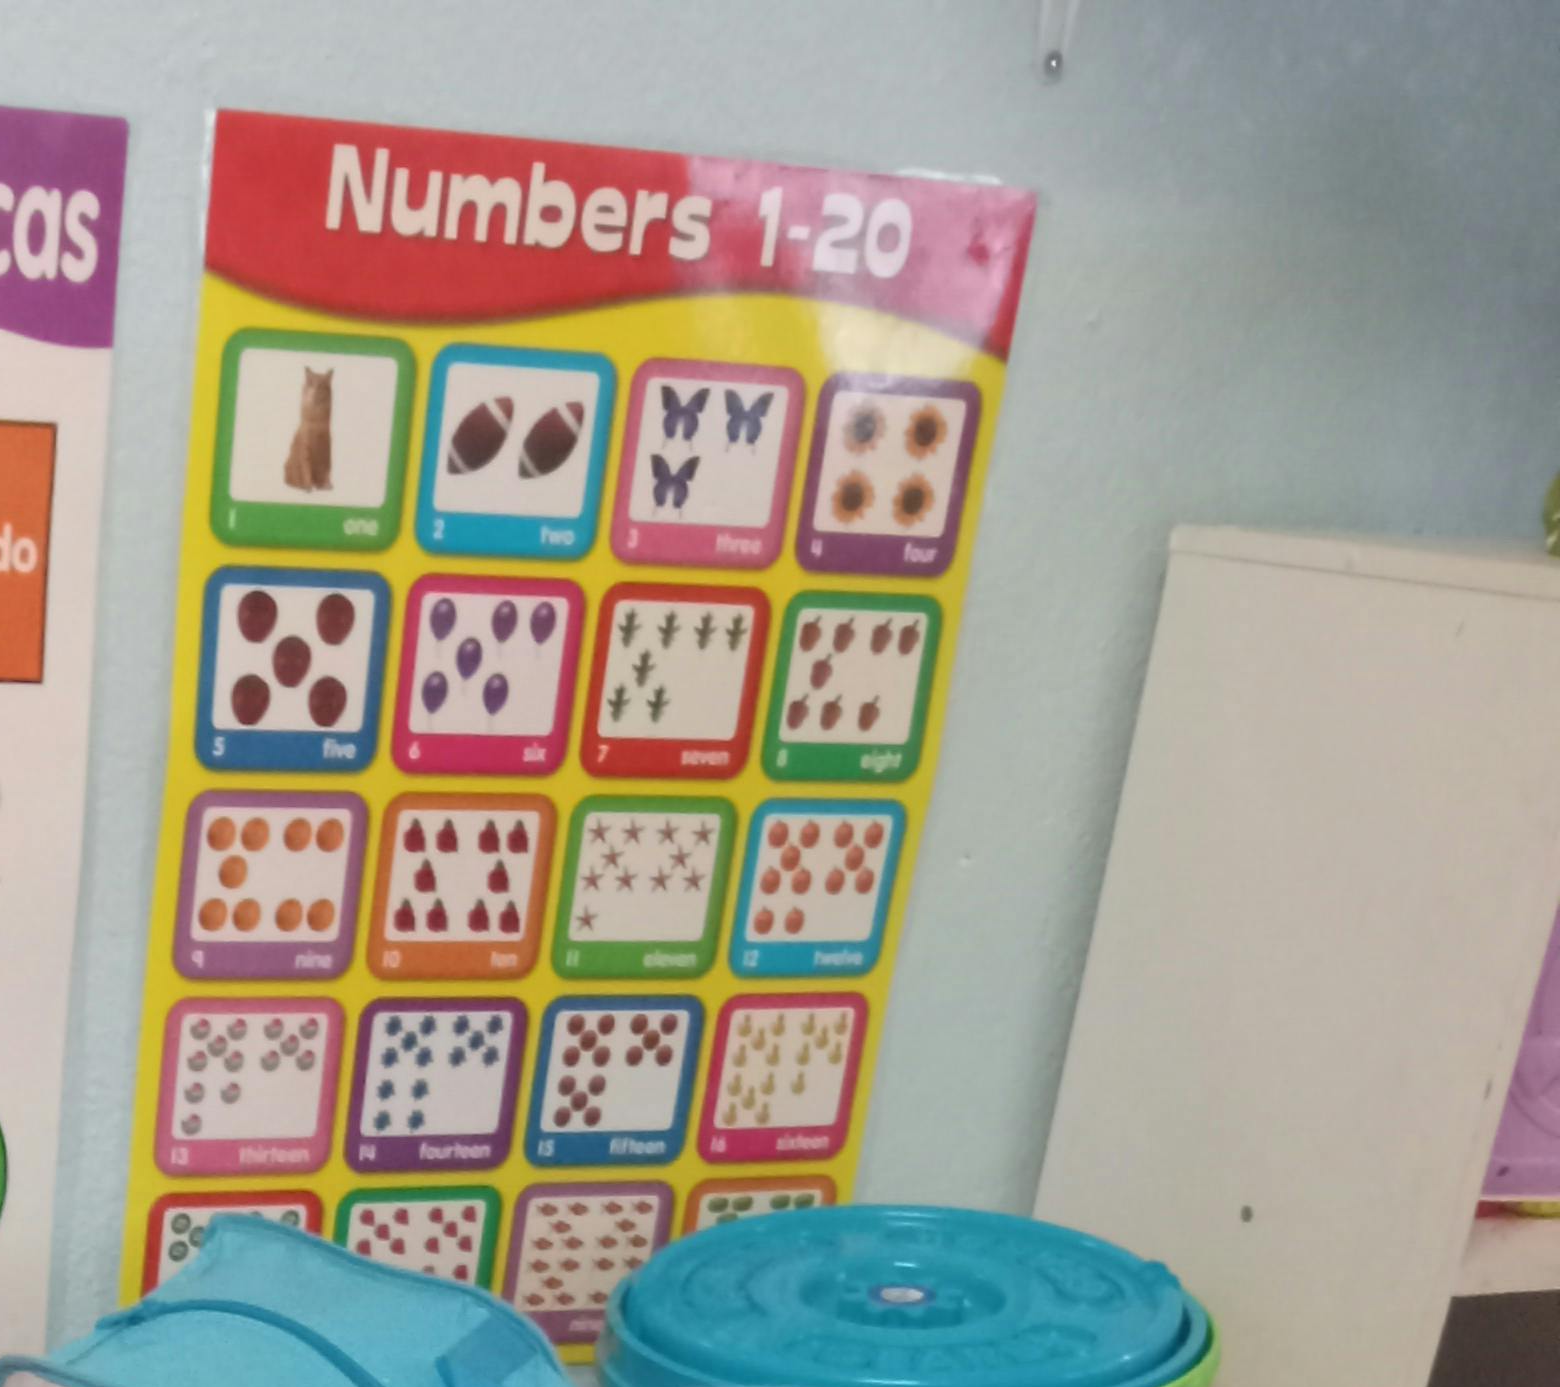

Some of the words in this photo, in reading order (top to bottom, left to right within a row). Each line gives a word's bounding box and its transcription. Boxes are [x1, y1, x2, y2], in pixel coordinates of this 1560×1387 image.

[325, 143, 712, 262] Numbers
[756, 186, 915, 280] 1-20
[343, 517, 380, 537] one
[433, 519, 445, 540] 2
[540, 526, 575, 546] two
[627, 529, 639, 549] 3
[716, 532, 762, 555] three
[811, 539, 823, 559] 4
[904, 542, 938, 563] four
[212, 737, 226, 757] 5
[322, 737, 357, 760] five
[408, 740, 421, 760] 6
[522, 742, 546, 763] six
[597, 745, 609, 764] 7
[681, 748, 730, 767] seven
[776, 747, 788, 768] 8
[860, 750, 903, 774] eight
[191, 949, 205, 969] 9
[295, 949, 333, 970] nine
[643, 949, 697, 969] eleven
[813, 949, 863, 968] twelve
[419, 1140, 491, 1161] fourteen
[609, 1137, 666, 1156] fifteen
